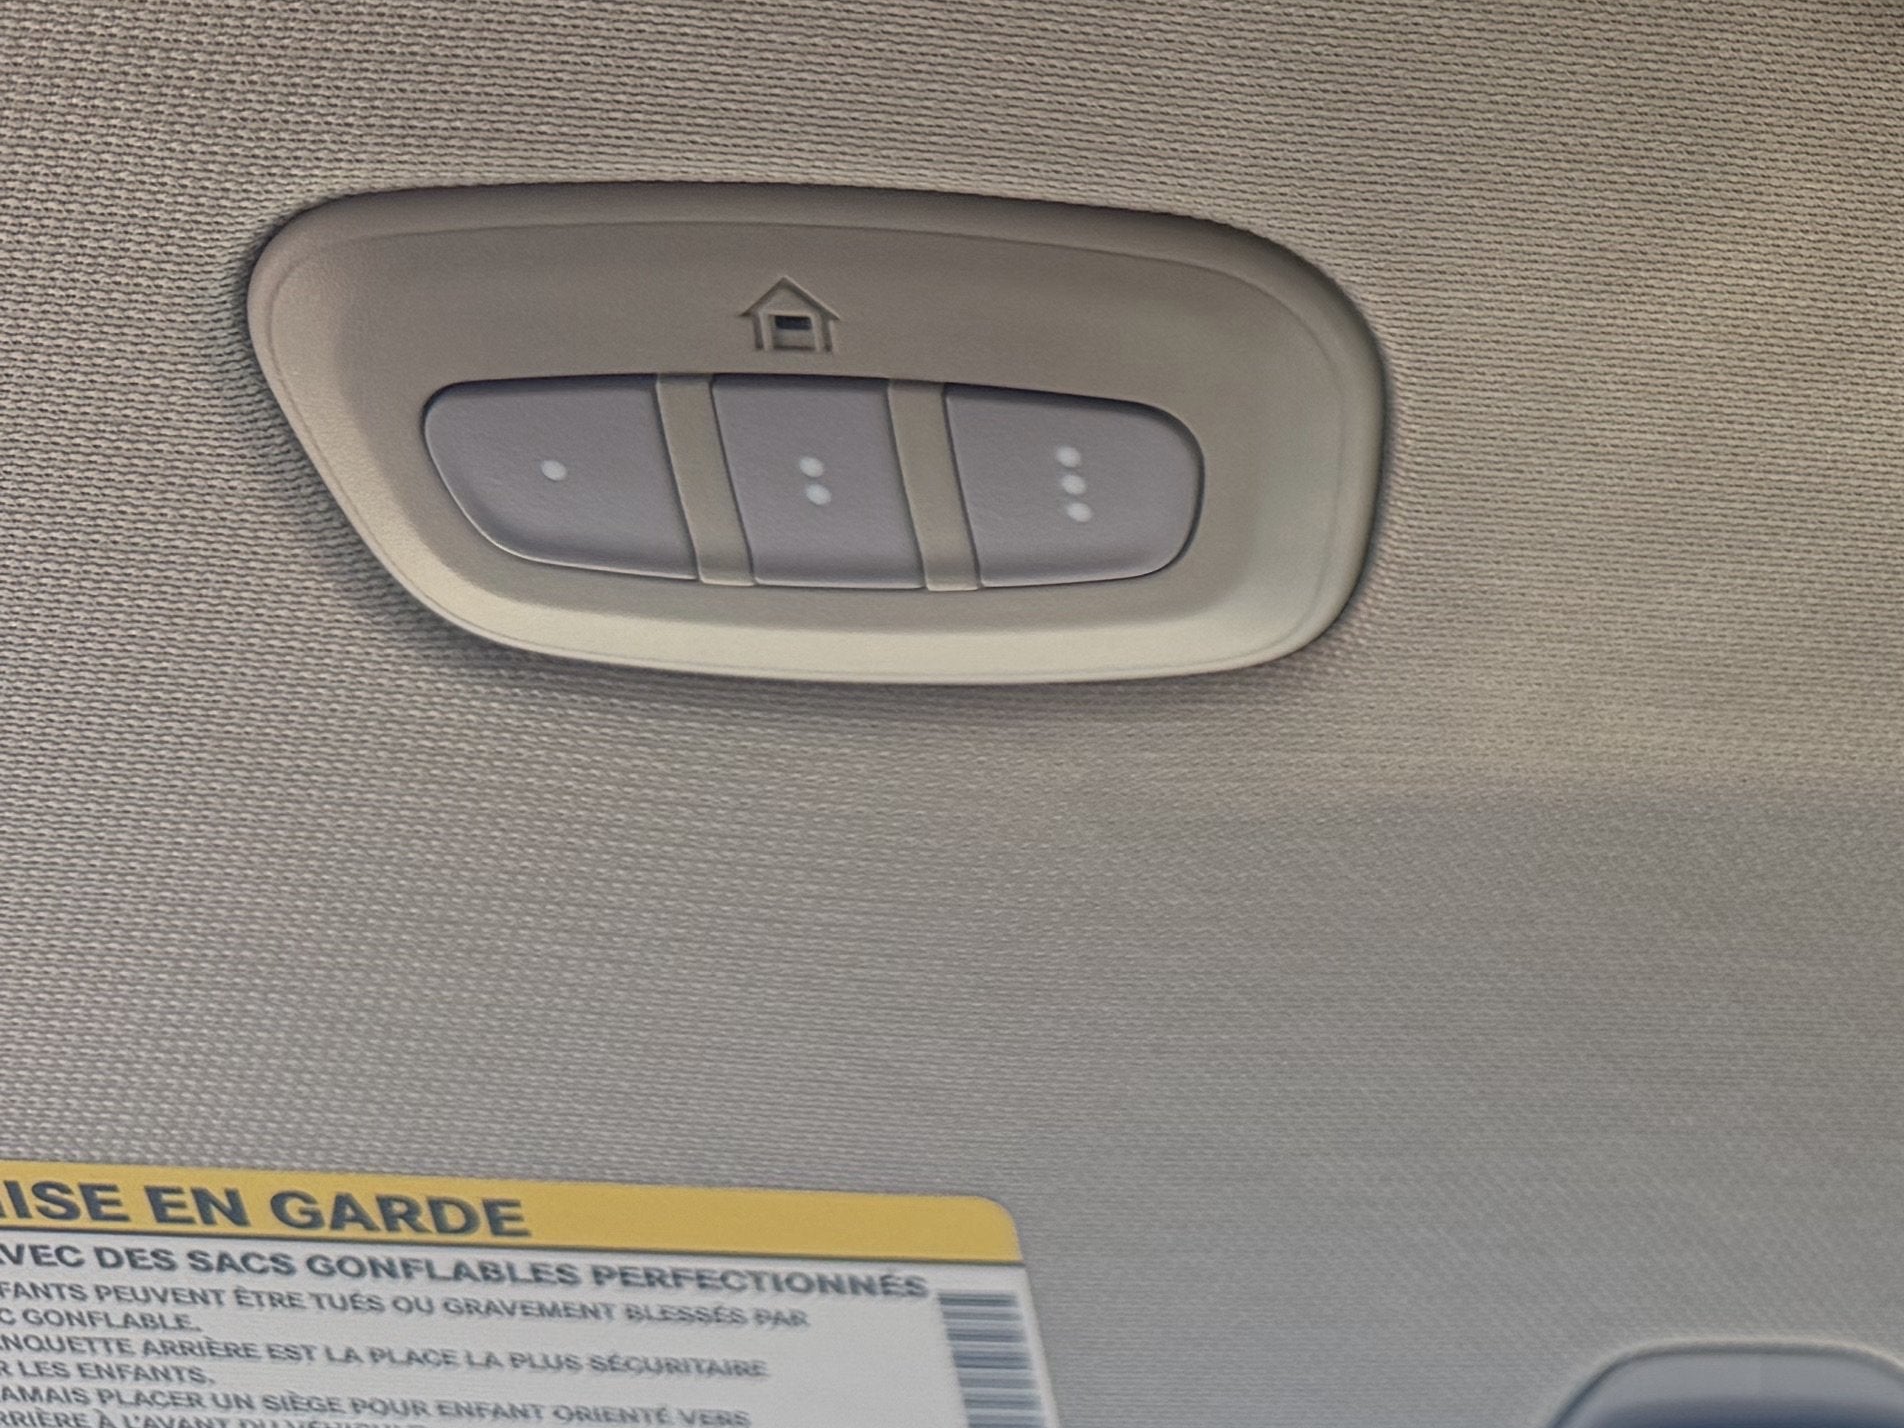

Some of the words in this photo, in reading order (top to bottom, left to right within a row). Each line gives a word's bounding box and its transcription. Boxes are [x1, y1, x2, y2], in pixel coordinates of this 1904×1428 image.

[0, 1180, 131, 1223] ISE
[144, 1184, 251, 1227] EN
[270, 1189, 533, 1238] GARDE
[0, 1243, 86, 1268] VEC
[93, 1246, 179, 1272] DES
[187, 1249, 297, 1276] SACS
[306, 1253, 582, 1287] GONFLABLES
[591, 1263, 930, 1299] PERFECTIONNÉS
[22, 1308, 203, 1333] GONFLABLE.
[94, 1283, 227, 1307] PEUVENT
[233, 1285, 306, 1310] ÊTRE
[308, 1289, 387, 1313] TUÉS
[392, 1295, 435, 1315] OU
[443, 1296, 616, 1321] GRAVEMENT
[624, 1303, 749, 1325] BLESSÉS
[753, 1307, 811, 1327] PAR
[0, 1333, 137, 1357] NQUETTE
[142, 1335, 262, 1360] ARRIÈRE
[266, 1343, 317, 1362] EST
[324, 1344, 364, 1364] LA
[367, 1345, 460, 1367] PLACE
[465, 1349, 503, 1368] LA
[508, 1351, 584, 1372] PLUS
[18, 1359, 71, 1379] LES
[77, 1362, 215, 1385] ENFANTS.
[96, 1388, 207, 1410] PLACER
[211, 1392, 255, 1410] UN
[262, 1389, 347, 1414] SIÈGE
[350, 1396, 432, 1417] POUR
[435, 1399, 544, 1420] ENFANT
[553, 1403, 671, 1425] ORIENTÉ
